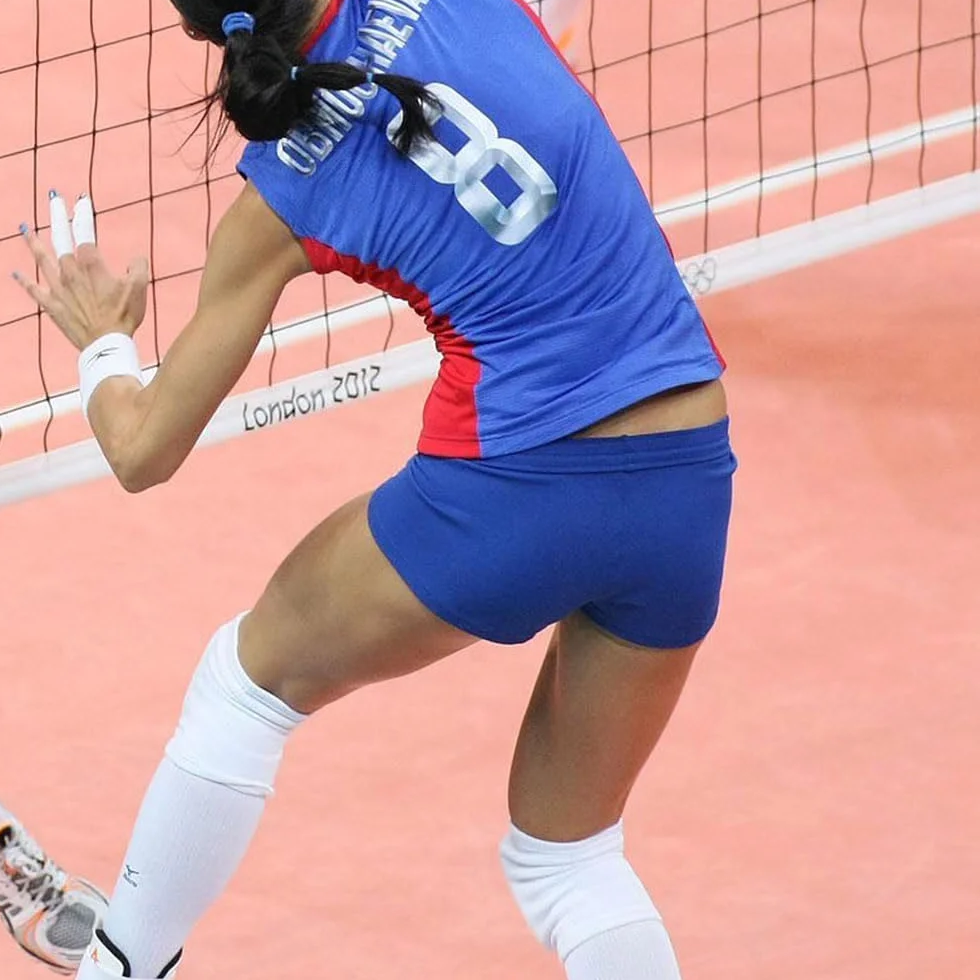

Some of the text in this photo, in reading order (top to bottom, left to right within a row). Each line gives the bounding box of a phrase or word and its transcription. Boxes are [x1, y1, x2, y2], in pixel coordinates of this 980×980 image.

[386, 82, 558, 246] 8
[242, 365, 381, 431] London 2012
